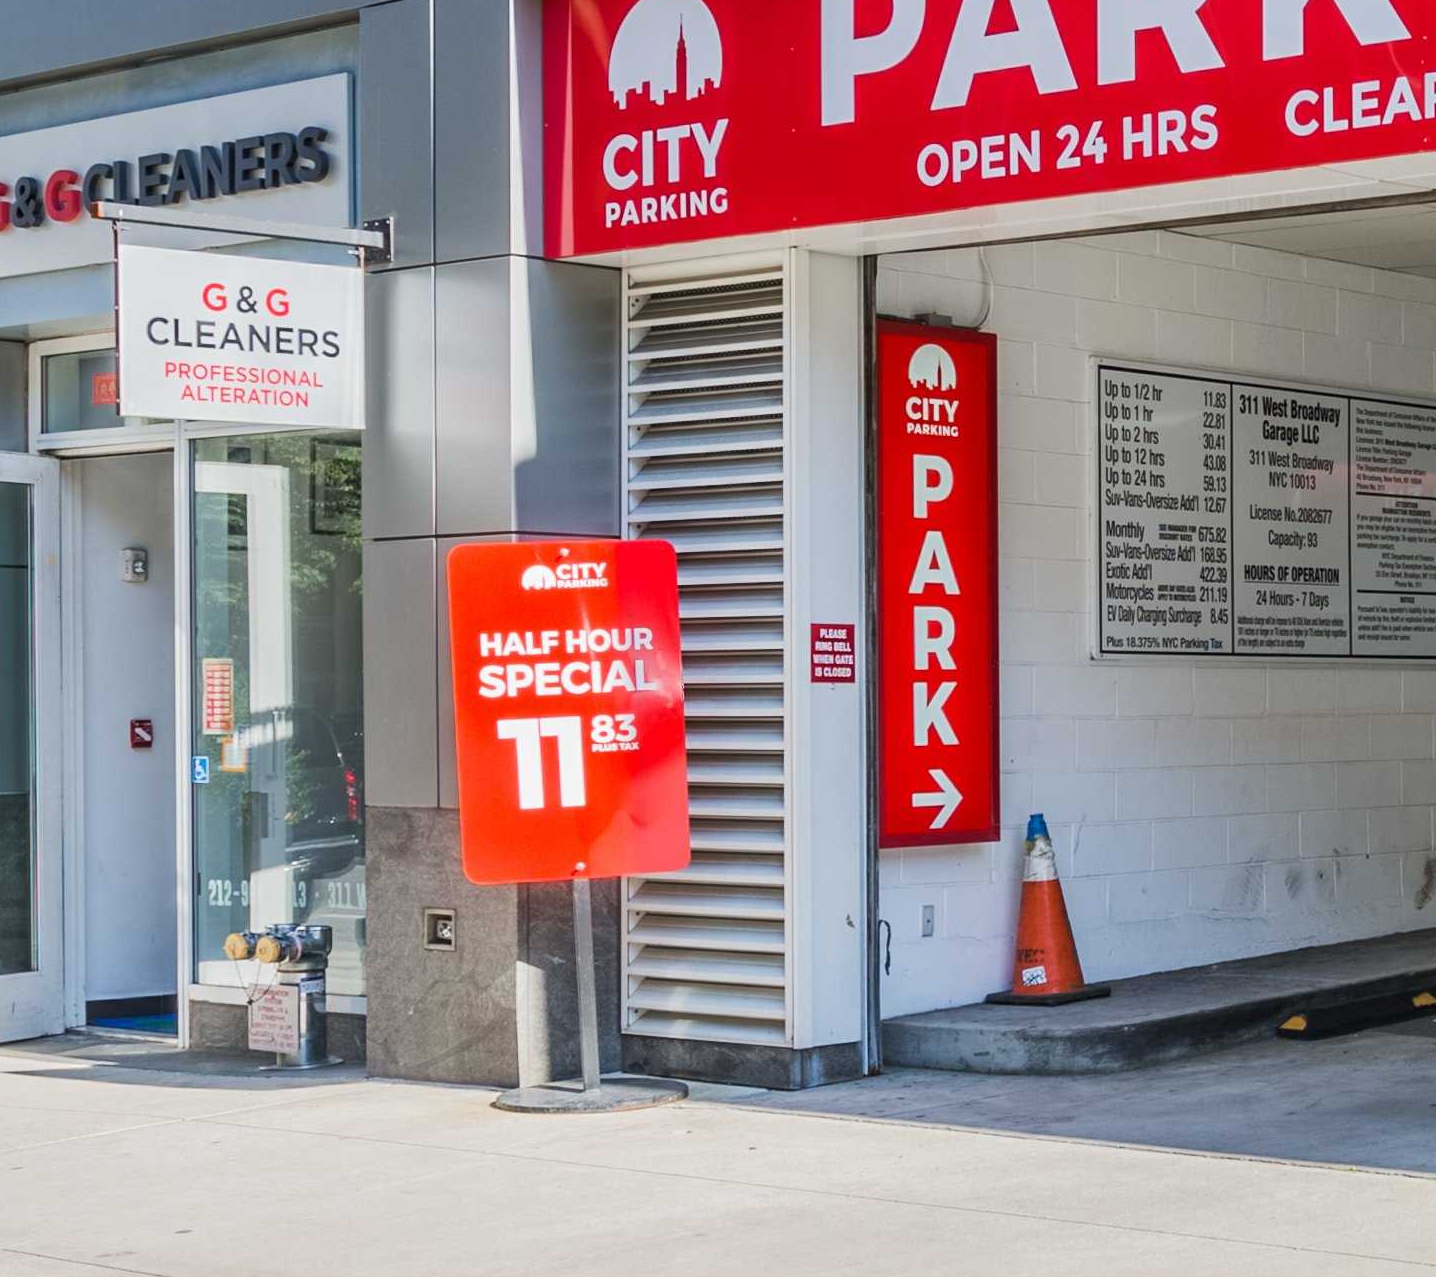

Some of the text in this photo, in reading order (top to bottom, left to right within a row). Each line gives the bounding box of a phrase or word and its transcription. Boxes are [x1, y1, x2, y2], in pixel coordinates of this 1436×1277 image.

[602, 118, 729, 191] CITY
[916, 104, 1218, 187] OPEN 24 HRS
[605, 187, 729, 228] PARKING
[202, 283, 290, 317] G & G
[146, 317, 340, 358] CLEANERS
[164, 361, 324, 389] PROFESSIONAL
[180, 384, 309, 408] ALTERATION
[1105, 379, 1227, 409] Up to 1/2 hr 11.83
[905, 396, 959, 423] CITY
[1105, 401, 1225, 430] Up to 1 hr 22.81
[1239, 394, 1258, 414] 311
[1262, 395, 1288, 418] West
[1290, 399, 1340, 428] Broadway
[906, 422, 959, 437] PARKING
[1105, 423, 1225, 450] Up to 2 hrs 30.41
[1263, 420, 1320, 446] Garage LLC
[1105, 444, 1226, 472] Up to 12 hrs 43.08
[1249, 449, 1334, 475] 311 West Broadway
[1105, 467, 1226, 493] Up to 24 hrs 59.13
[1269, 471, 1316, 490] NYC 10013
[1205, 497, 1226, 513] 12.67
[1249, 504, 1282, 522] License
[1106, 521, 1145, 542] Monthly
[1198, 526, 1227, 543] 675.82
[1268, 529, 1318, 550] Capacity: 93
[1200, 547, 1227, 564] 168.95
[556, 562, 607, 580] CITY
[556, 578, 609, 589] PARKING
[1106, 562, 1130, 579] Exotic
[1200, 566, 1227, 584] 422.39
[1244, 564, 1340, 583] HOURS OF OPERATION
[908, 453, 961, 748] PARK
[1106, 582, 1154, 604] Motorcycles
[1199, 586, 1227, 603] 211.19
[1256, 590, 1267, 605] 24
[1269, 590, 1294, 606] Hours
[1301, 591, 1307, 606] 7
[1309, 591, 1330, 611] Days
[1107, 605, 1117, 622] EV
[1118, 605, 1135, 626] Daily
[1137, 605, 1167, 626] Charging
[1168, 606, 1202, 627] Surcharge
[1210, 608, 1228, 624] 8.45
[479, 627, 653, 657] HALF HOUR
[820, 628, 847, 639] PLEASE
[834, 641, 852, 652] BELL
[1106, 636, 1223, 651] Plus 18.375% NYC Parking Tax
[478, 658, 660, 699] SPECIAL
[823, 666, 852, 677] CLOSED
[496, 714, 637, 810] 11 83
[328, 881, 352, 908] 311
